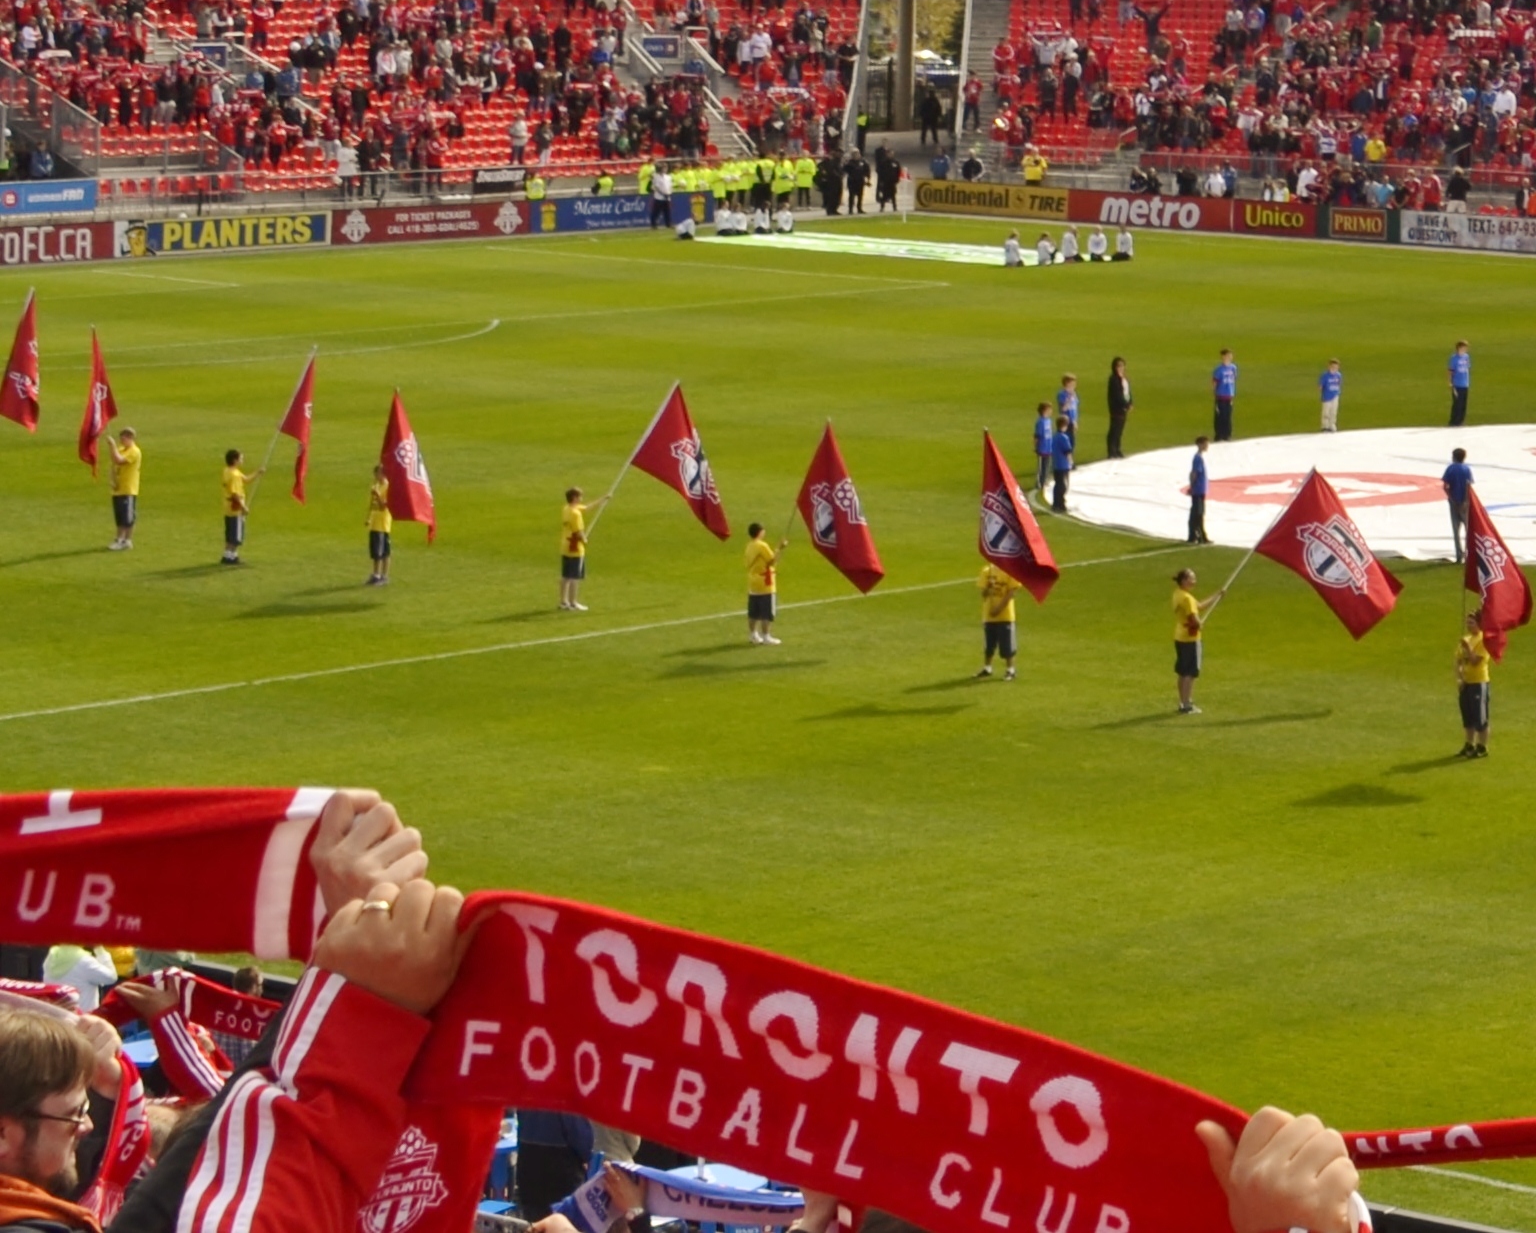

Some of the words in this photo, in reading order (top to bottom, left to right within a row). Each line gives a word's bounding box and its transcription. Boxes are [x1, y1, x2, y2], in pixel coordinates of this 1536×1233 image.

[574, 200, 613, 216] Monte
[615, 198, 646, 214] Carlo
[916, 181, 1010, 209] Continental
[1029, 194, 1066, 213] TIRE
[1101, 196, 1200, 228] metro
[1246, 199, 1304, 228] Unico
[1334, 212, 1383, 234] PRIMO
[1417, 215, 1440, 229] HAVE
[1442, 217, 1449, 229] A
[1468, 218, 1497, 235] TEXT:
[162, 216, 312, 250] PLANTERS
[1408, 227, 1458, 244] QUESTION?
[500, 901, 1110, 1169] TORONTO
[458, 1019, 866, 1182] FOOTBALL
[928, 1151, 1133, 1233] CLUB
